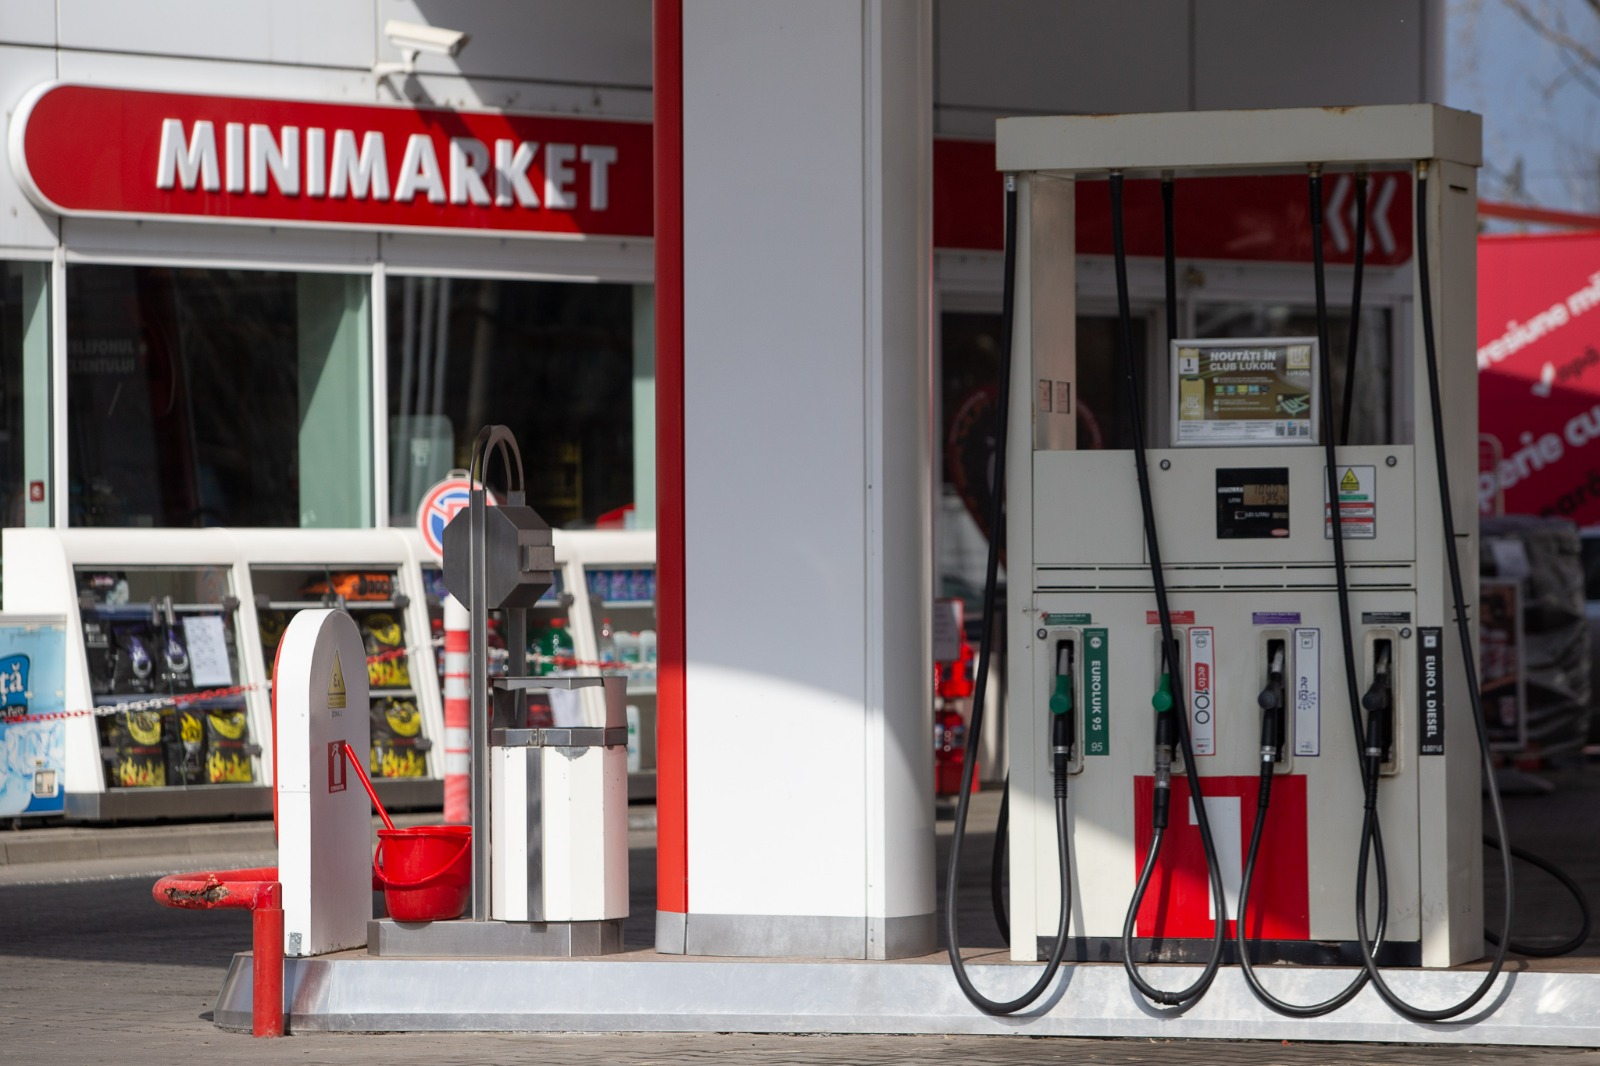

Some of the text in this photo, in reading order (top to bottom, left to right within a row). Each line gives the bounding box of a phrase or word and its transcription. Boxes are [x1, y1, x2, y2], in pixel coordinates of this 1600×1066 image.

[156, 117, 618, 211] MINIMARKET
[1210, 362, 1277, 371] CLUB LUKOIL
[1264, 349, 1276, 362] ÎN
[1425, 655, 1436, 687] EURO
[1091, 660, 1102, 731] EUROLUK 95
[1300, 676, 1310, 700] ecto
[1426, 700, 1437, 737] DIESEL
[1090, 741, 1103, 752] 95
[1189, 796, 1242, 921] 1
